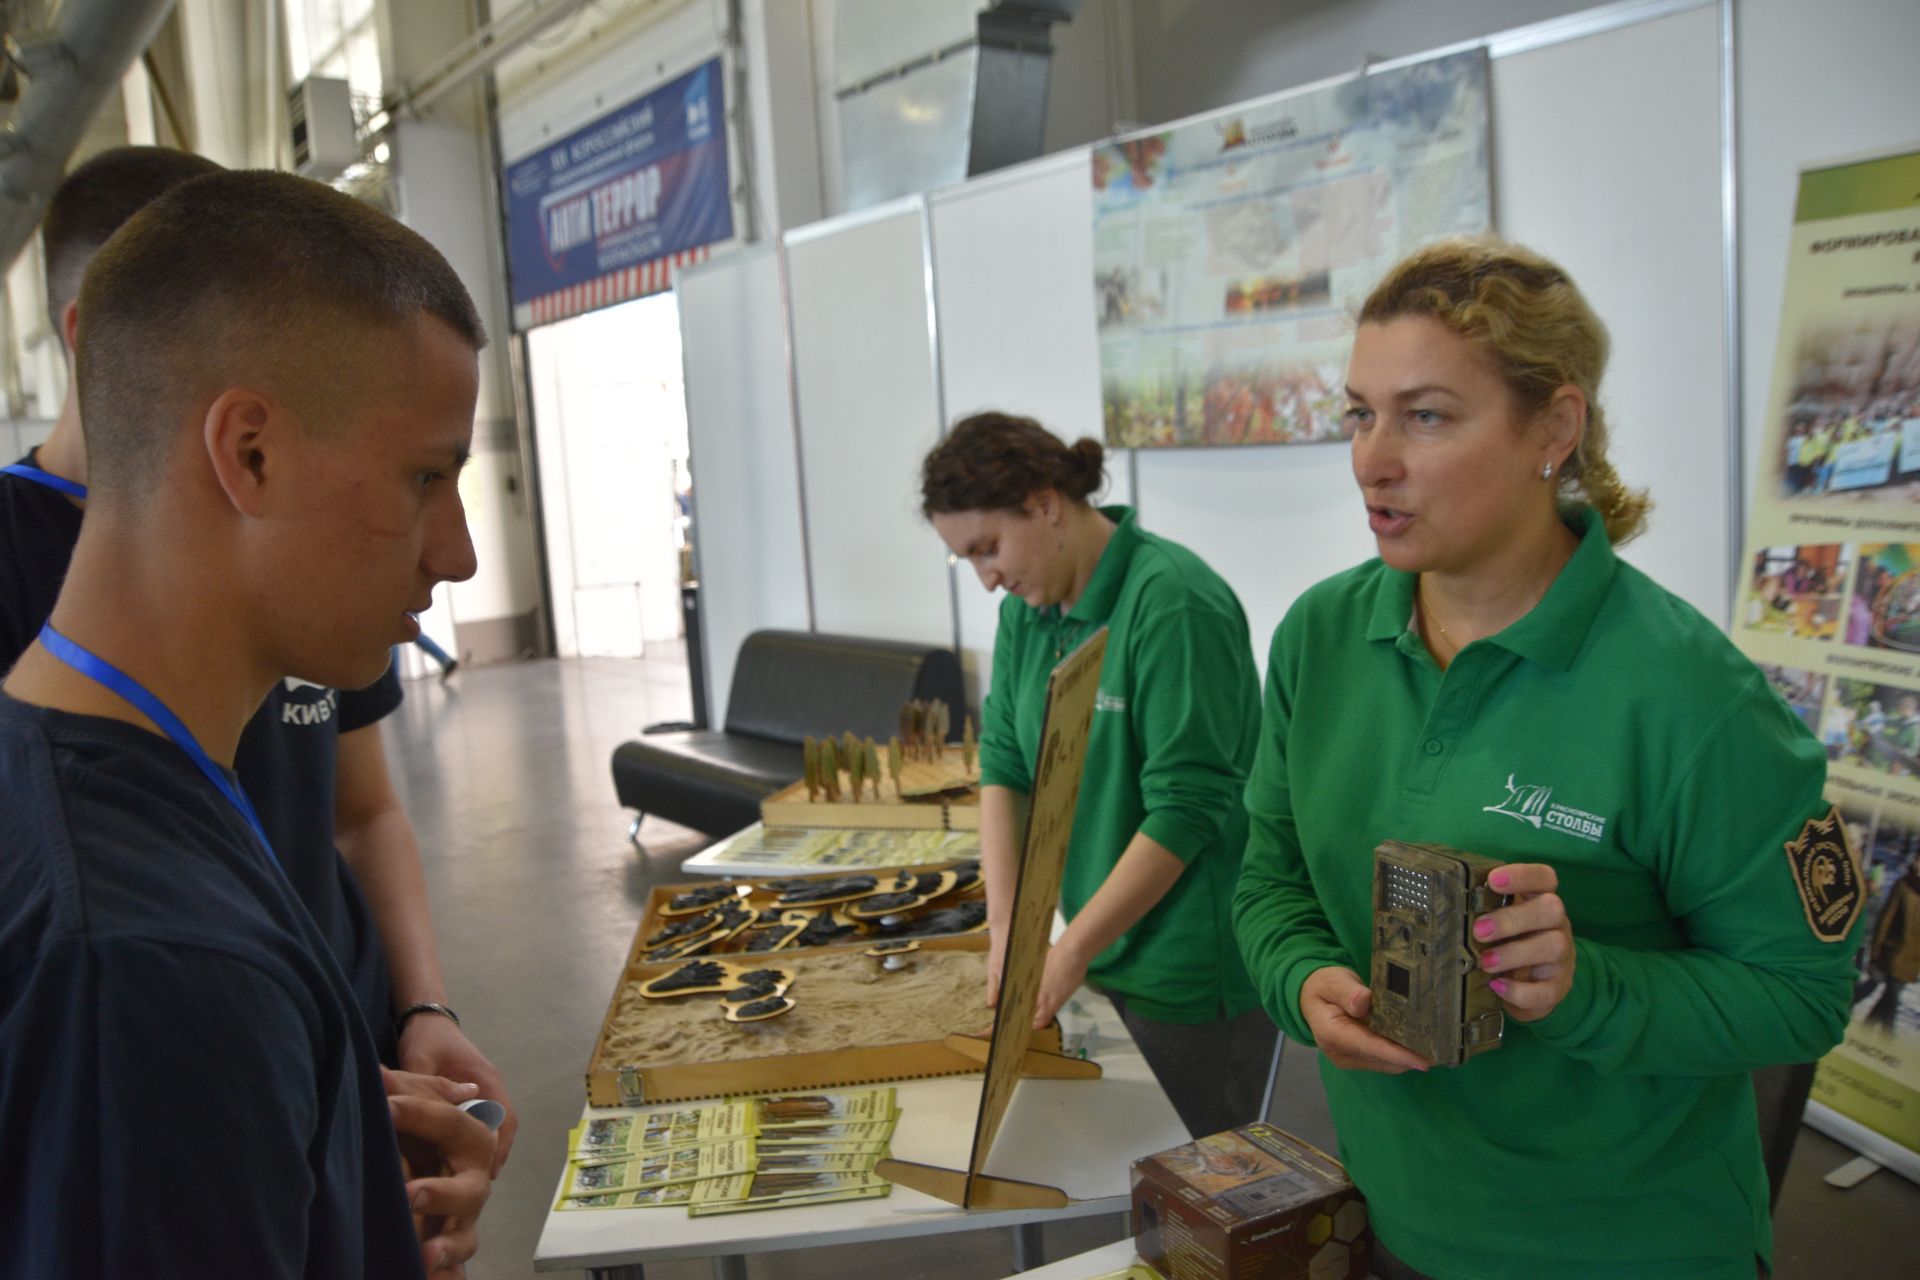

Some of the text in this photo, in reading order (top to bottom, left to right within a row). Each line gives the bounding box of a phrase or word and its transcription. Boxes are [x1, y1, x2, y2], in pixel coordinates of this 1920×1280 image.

[593, 166, 661, 232] ТЕРРОР
[1546, 812, 1603, 835] СТОЛБЫ
[1248, 1127, 1272, 1138] 12
